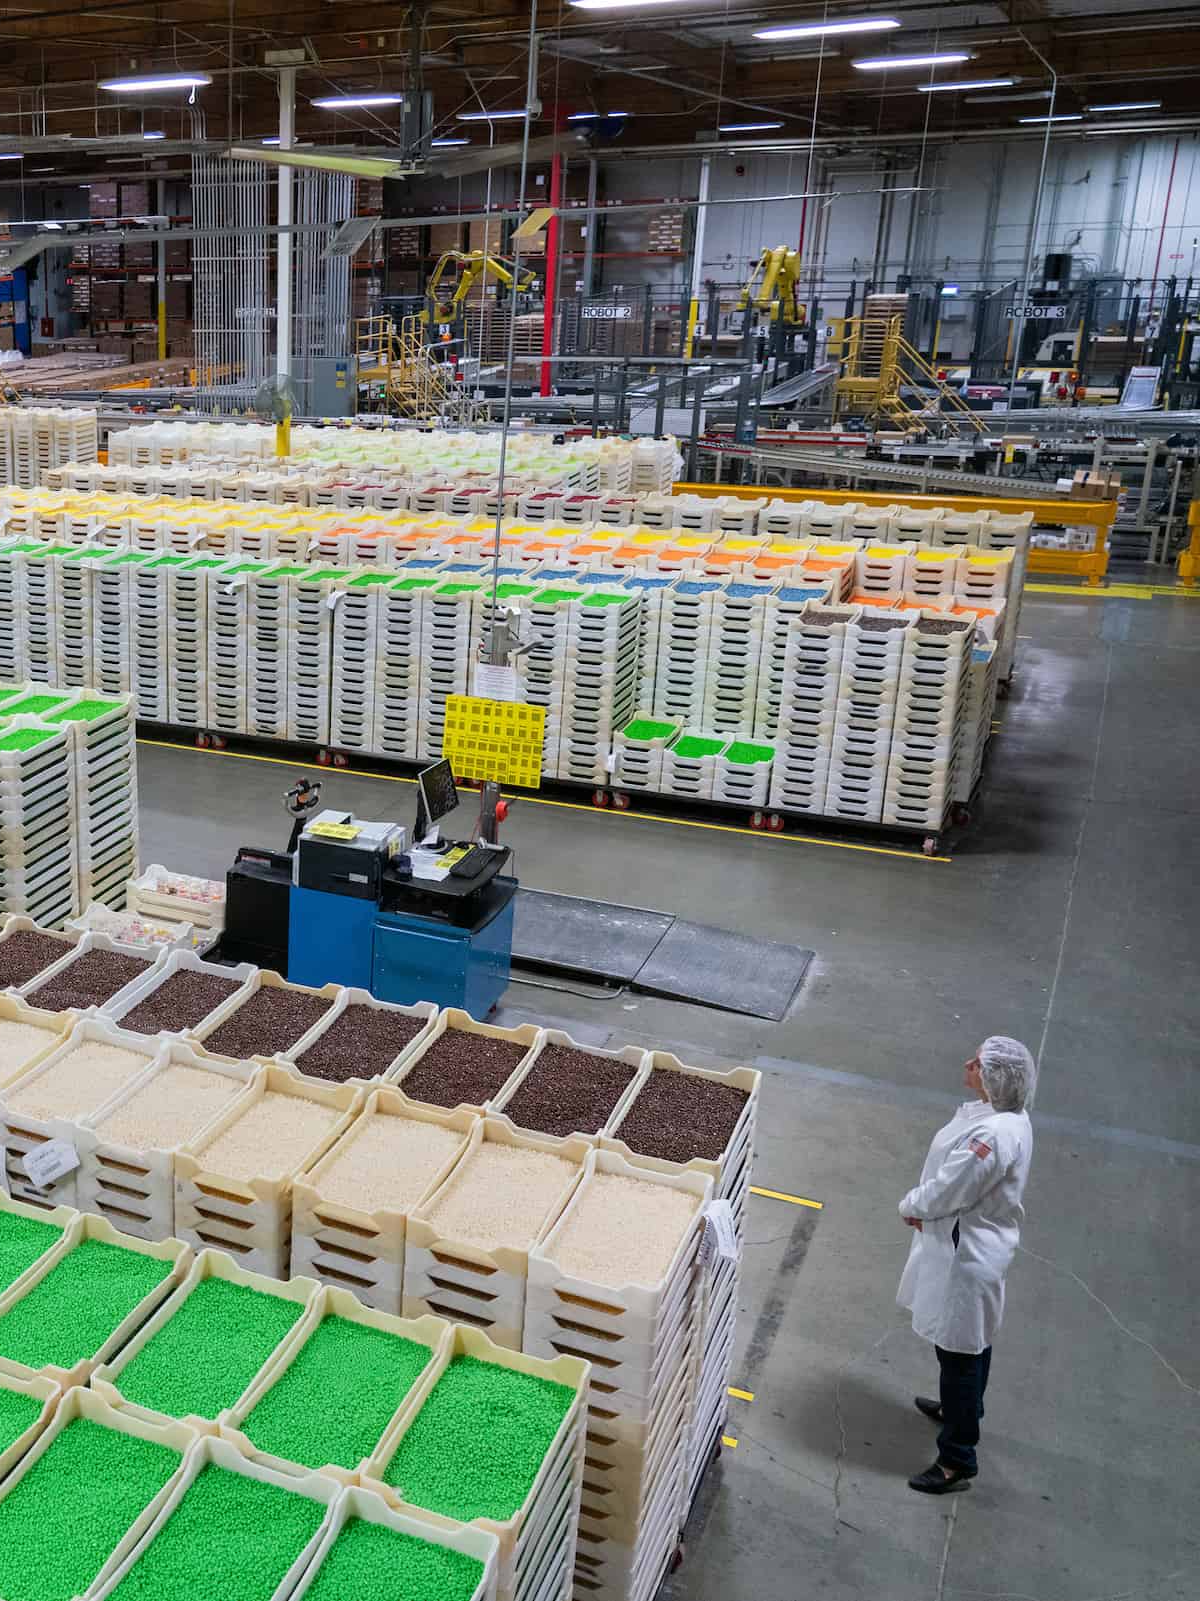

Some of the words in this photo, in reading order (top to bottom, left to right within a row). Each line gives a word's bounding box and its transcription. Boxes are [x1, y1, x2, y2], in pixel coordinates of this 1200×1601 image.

[584, 308, 618, 317] ROBOT
[623, 308, 630, 317] 2
[1005, 307, 1050, 317] ROBOT
[1056, 307, 1064, 317] 3
